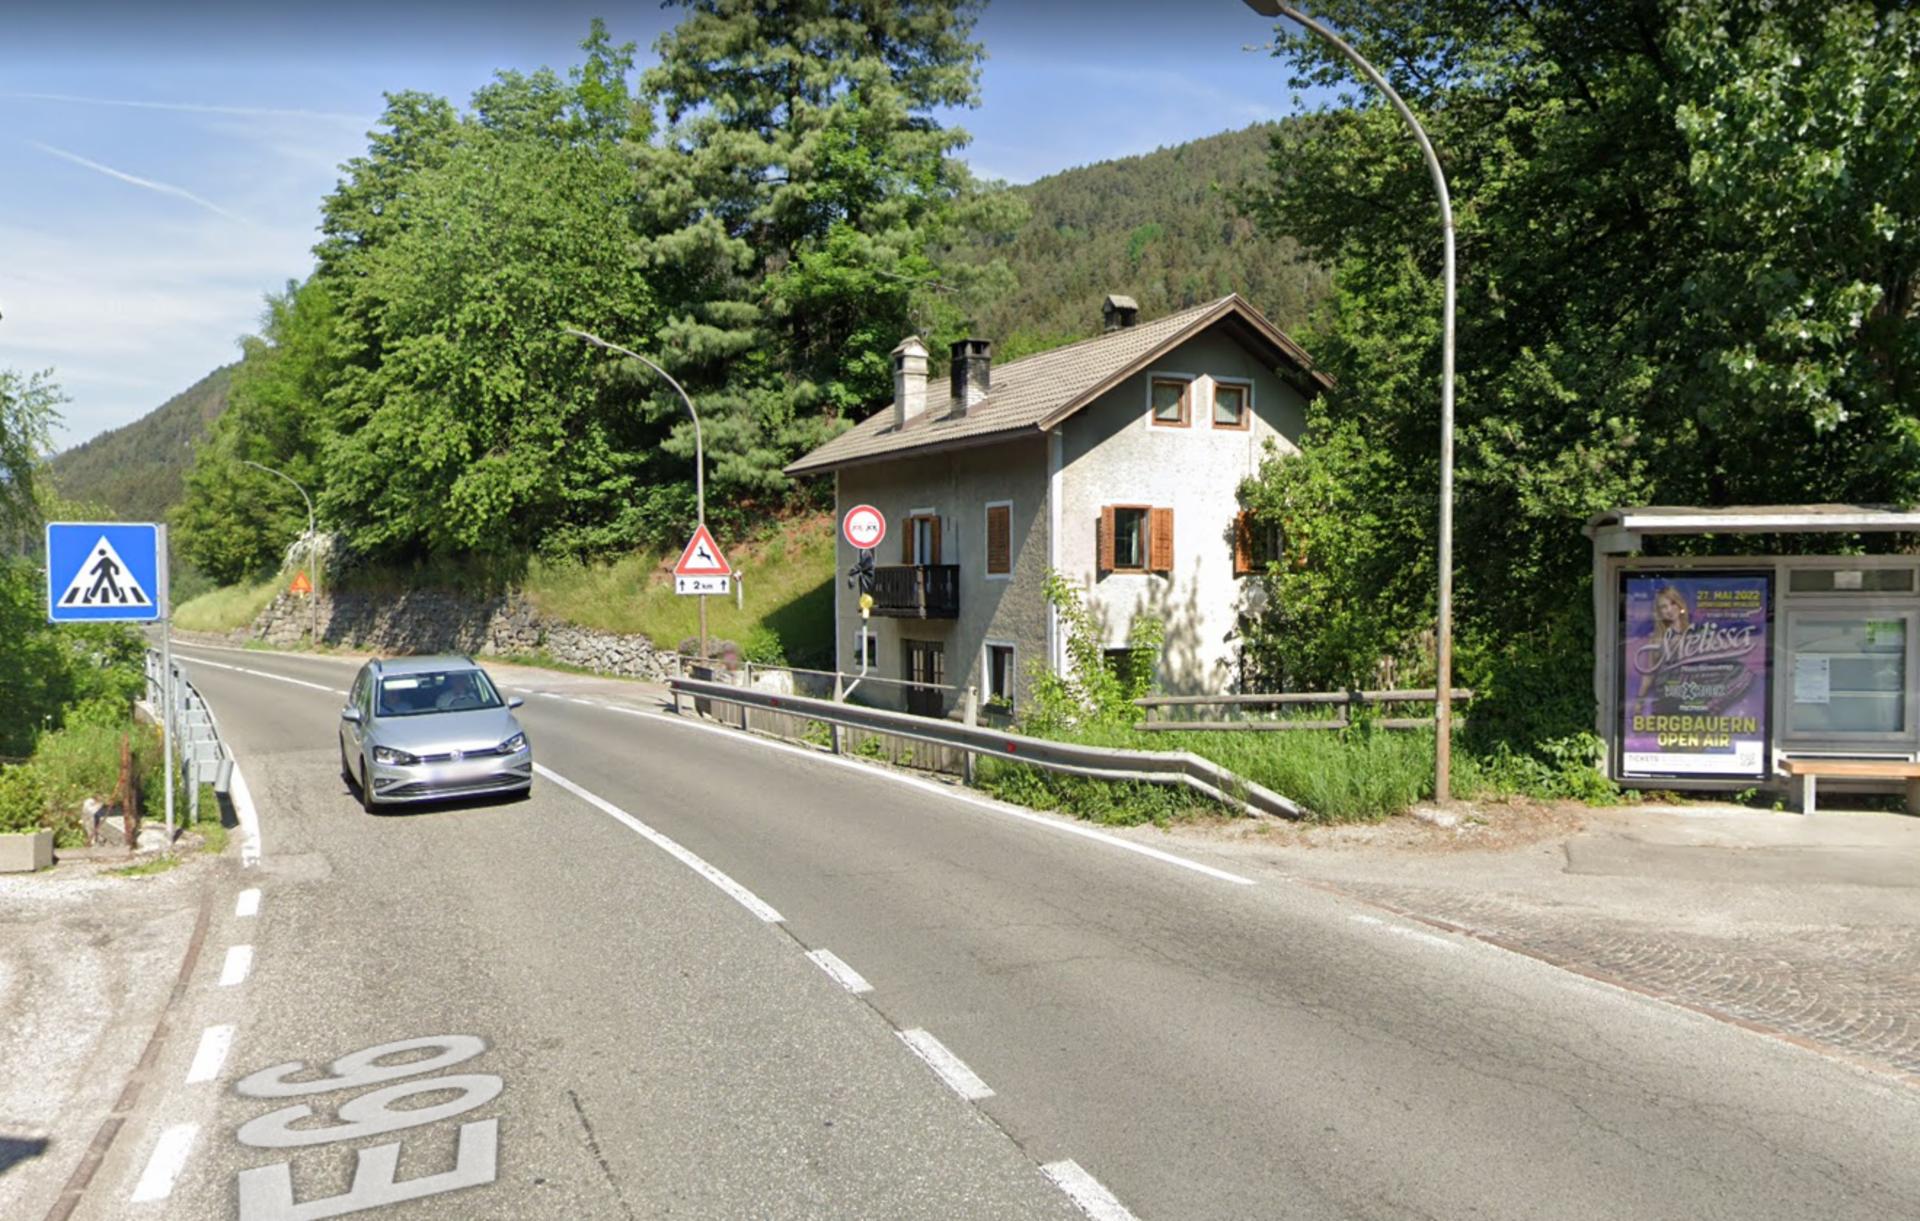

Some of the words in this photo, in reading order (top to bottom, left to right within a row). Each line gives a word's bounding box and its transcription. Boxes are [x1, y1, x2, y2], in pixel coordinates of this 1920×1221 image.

[693, 580, 700, 590] 2
[1734, 590, 1761, 600] 2022
[1636, 621, 1757, 669] Melissa
[1633, 716, 1757, 732] BERGBAUERN
[1658, 733, 1699, 746] OPEN
[1703, 734, 1731, 747] AIR
[236, 1034, 503, 1221] E66
